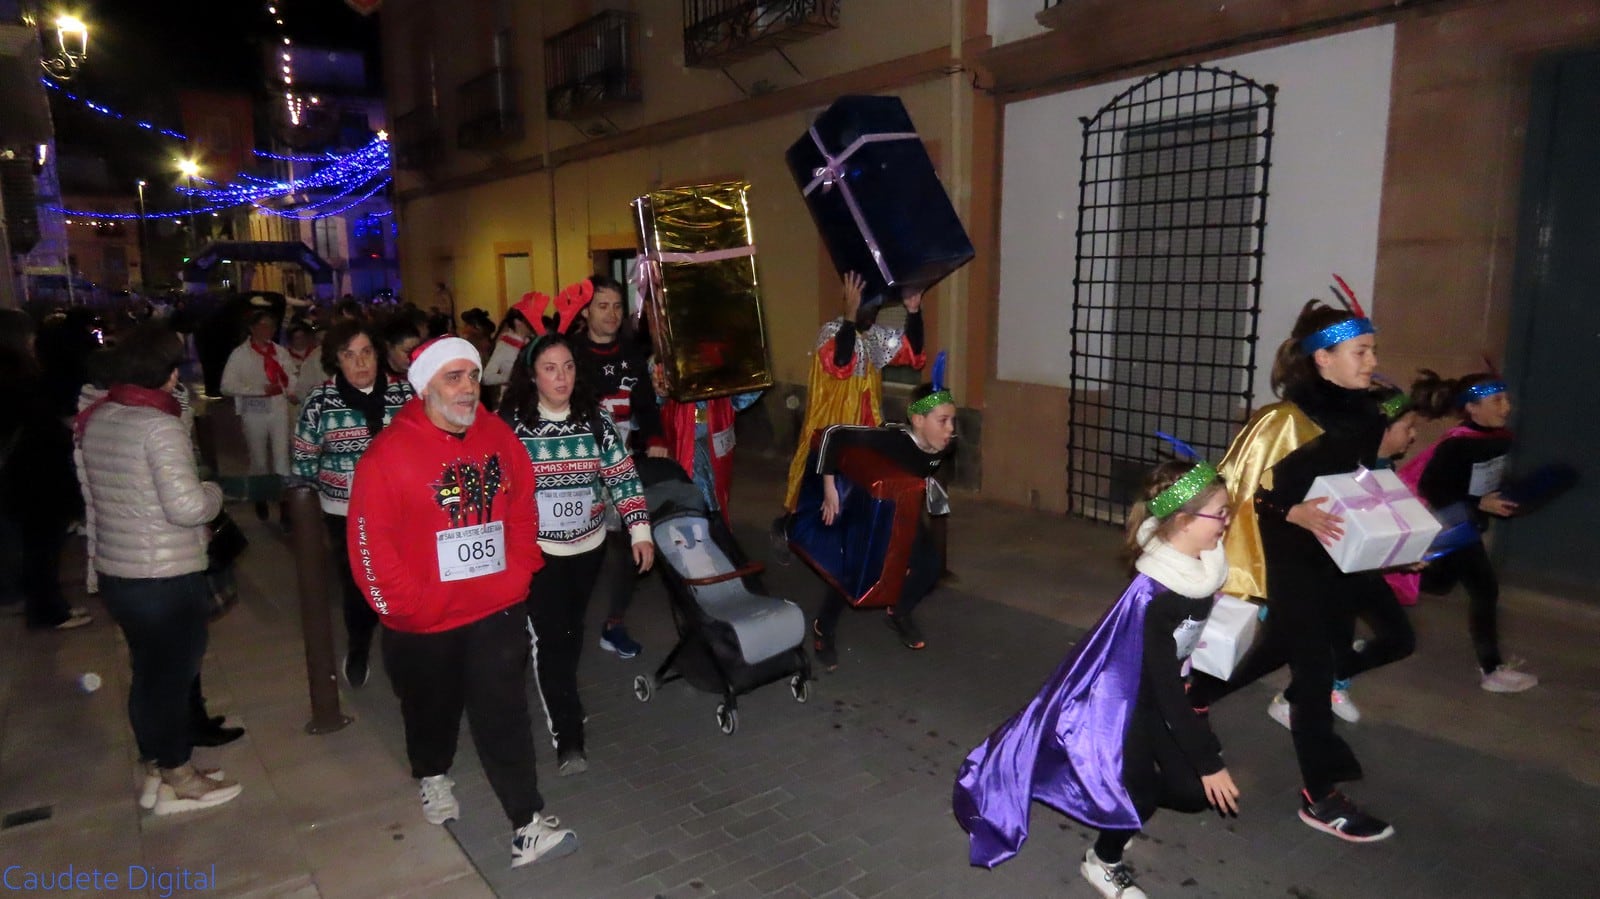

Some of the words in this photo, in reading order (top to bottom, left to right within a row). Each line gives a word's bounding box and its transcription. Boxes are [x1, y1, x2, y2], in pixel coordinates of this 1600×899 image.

[534, 463, 563, 473] XMAS
[568, 461, 598, 472] MERRY
[553, 501, 583, 518] 088
[458, 538, 496, 562] 085
[369, 586, 389, 615] MERRY
